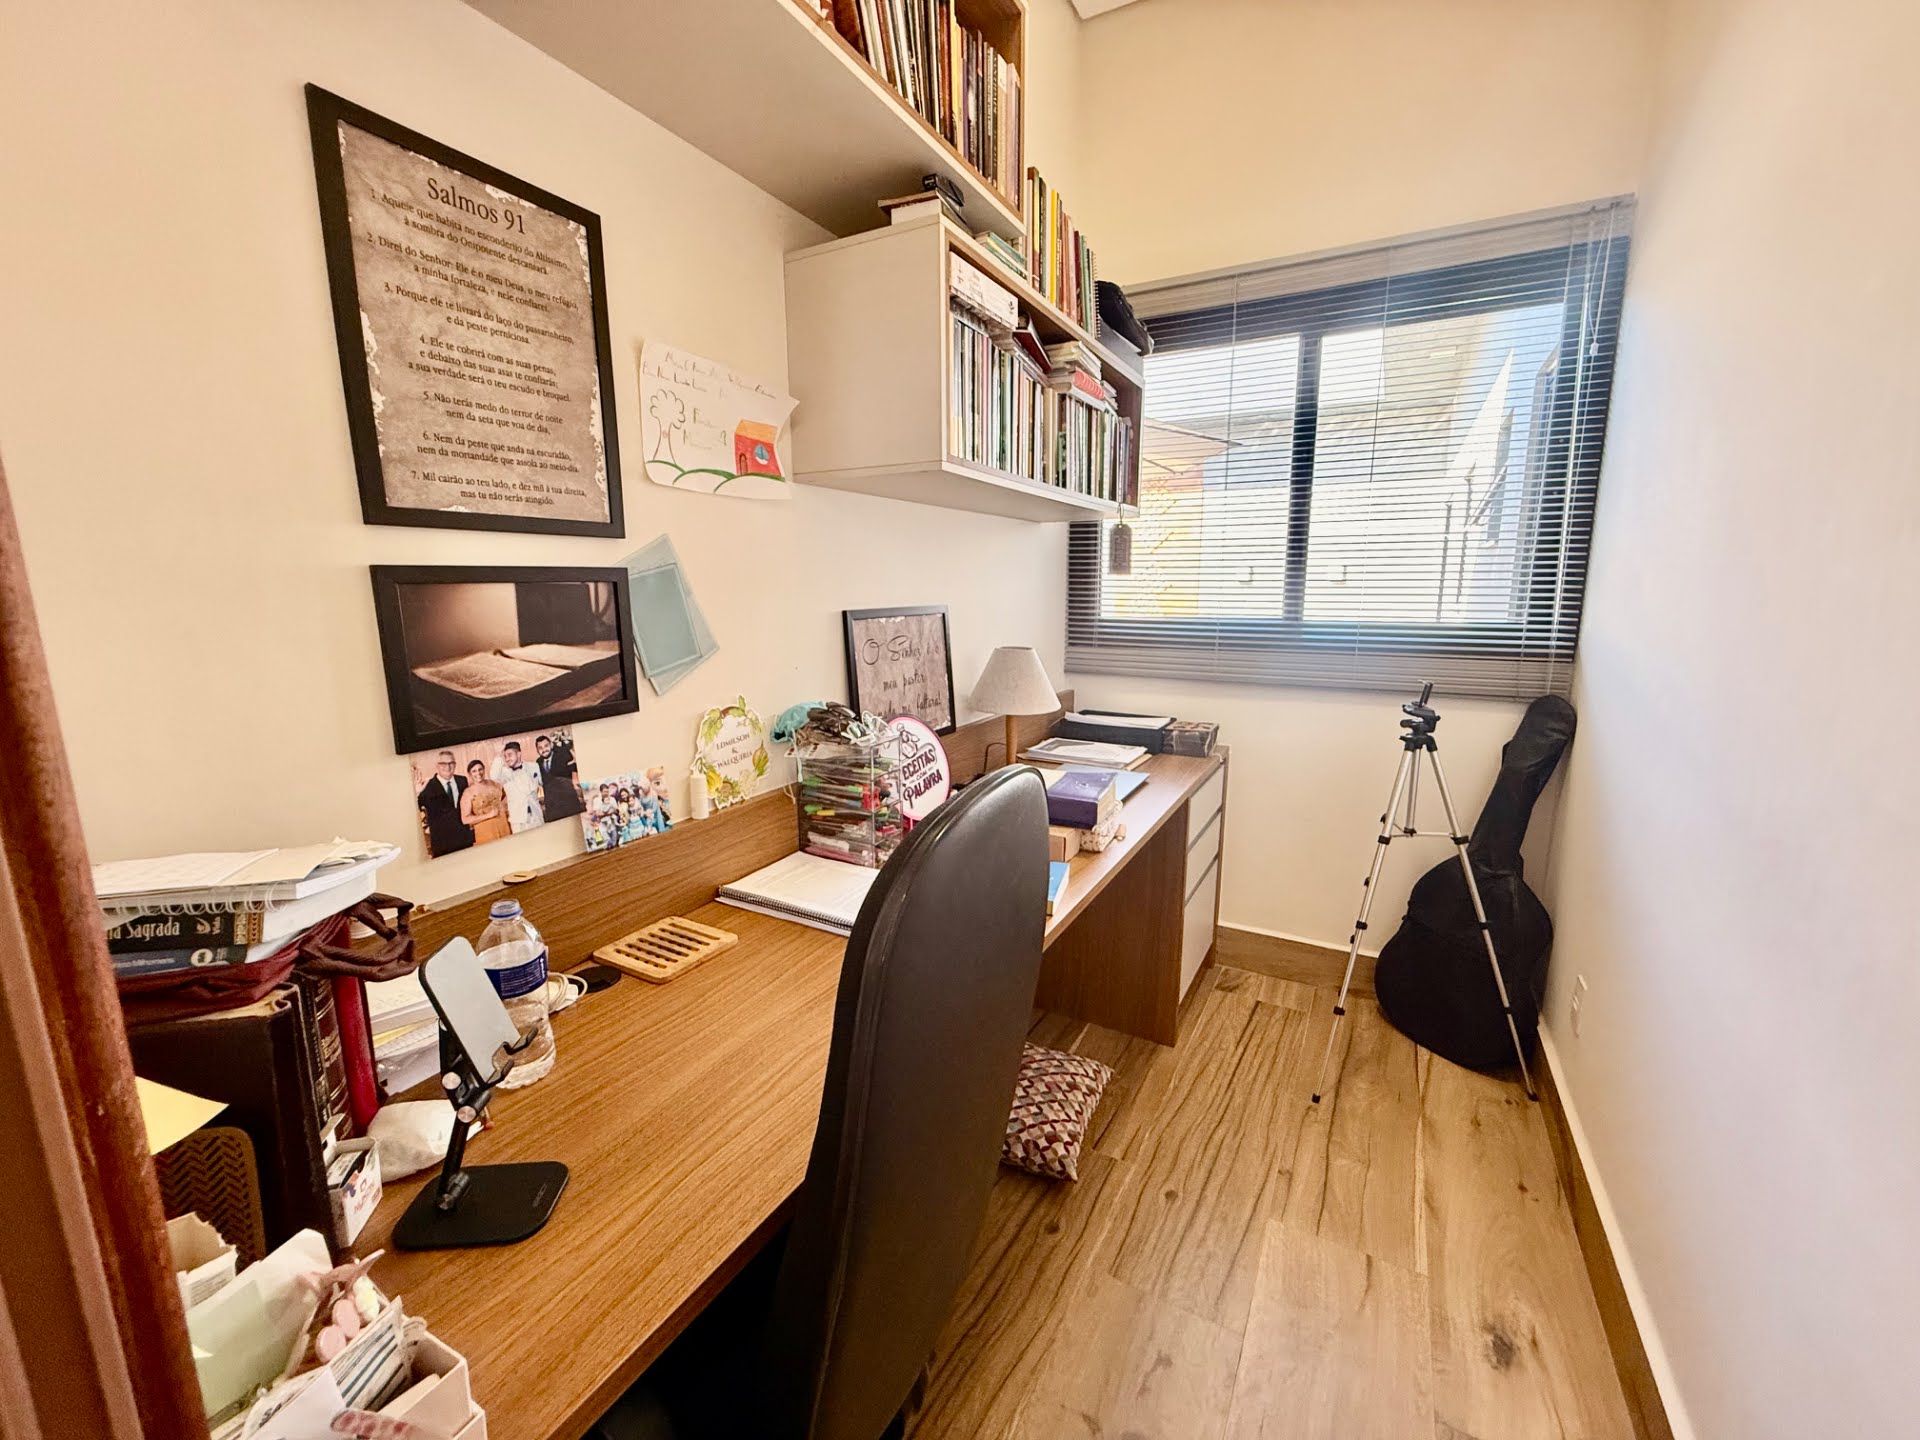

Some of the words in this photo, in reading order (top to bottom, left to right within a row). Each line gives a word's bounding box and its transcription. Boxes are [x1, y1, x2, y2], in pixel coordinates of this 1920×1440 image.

[427, 177, 498, 224] Salmos
[504, 209, 526, 235] 91
[381, 193, 415, 213] Aquele
[416, 208, 434, 219] que
[464, 226, 475, 236] no
[524, 246, 534, 257] do
[411, 220, 445, 239] sombra
[447, 232, 458, 243] do
[378, 235, 403, 253] Direi
[405, 246, 417, 257] do
[456, 261, 469, 274] Ele
[471, 266, 477, 277] é
[486, 273, 503, 286] meu
[535, 289, 550, 301] meu
[413, 264, 419, 272] a
[421, 267, 449, 282] minha
[450, 274, 489, 296] fortaleza,
[497, 291, 514, 302] nele
[384, 282, 393, 293] 3.
[396, 285, 428, 303] Porque
[430, 296, 444, 308] ele
[445, 301, 454, 310] te
[455, 302, 482, 318] livrará
[483, 311, 494, 322] do
[495, 314, 512, 328] laço
[513, 320, 524, 330] do
[453, 316, 465, 327] da
[466, 320, 488, 333] peste
[419, 334, 428, 344] 4.
[429, 336, 444, 348] Ele
[446, 341, 455, 351] te
[456, 345, 486, 358] cobrirá
[487, 353, 504, 363] com
[505, 357, 514, 365] as
[515, 359, 532, 369] suas
[533, 364, 557, 377] penas,
[420, 350, 425, 358] e
[427, 350, 461, 366] debaixo
[463, 359, 477, 370] das
[478, 364, 496, 374] suas
[497, 368, 513, 377] asas
[515, 370, 523, 380] te
[408, 361, 414, 369] a
[415, 363, 431, 373] sua
[432, 366, 467, 381] verdade
[468, 374, 485, 384] será
[487, 378, 493, 386] o
[494, 379, 507, 389] teu
[508, 384, 535, 395] escudo
[434, 392, 451, 404] Não
[453, 397, 473, 408] terás
[475, 402, 497, 412] medo
[499, 405, 509, 415] do
[511, 409, 533, 419] terror
[534, 412, 544, 422] de
[445, 410, 465, 420] nem
[466, 412, 476, 422] da
[478, 416, 494, 425] seta
[495, 418, 510, 428] que
[511, 421, 525, 430] voa
[526, 423, 536, 432] de
[537, 424, 551, 435] dia,
[417, 445, 436, 455] nem
[438, 447, 449, 456] da
[451, 450, 499, 463] mortandade
[500, 457, 514, 466] que
[516, 459, 538, 468] assola
[422, 430, 431, 440] 6.
[433, 432, 454, 444] Nem
[455, 436, 465, 446] da
[467, 439, 489, 449] peste
[490, 442, 505, 452] que
[507, 445, 525, 455] anda
[526, 448, 535, 456] na
[410, 470, 420, 480] 7.
[422, 471, 436, 482] Mil
[438, 474, 464, 485] cairão
[465, 478, 475, 486] ao
[477, 478, 490, 487] teu
[491, 478, 511, 490] lado,
[518, 482, 532, 491] dez
[533, 484, 544, 492] mil
[563, 487, 587, 497] direita,
[460, 490, 477, 498] mas
[478, 492, 487, 500] tu
[488, 492, 503, 501] não
[504, 494, 523, 503] serás
[862, 638, 884, 665] O
[883, 680, 898, 692] meu
[902, 748, 936, 780] ECEITAS
[903, 769, 943, 808] PALAVRA
[125, 917, 180, 941] Sagrada
